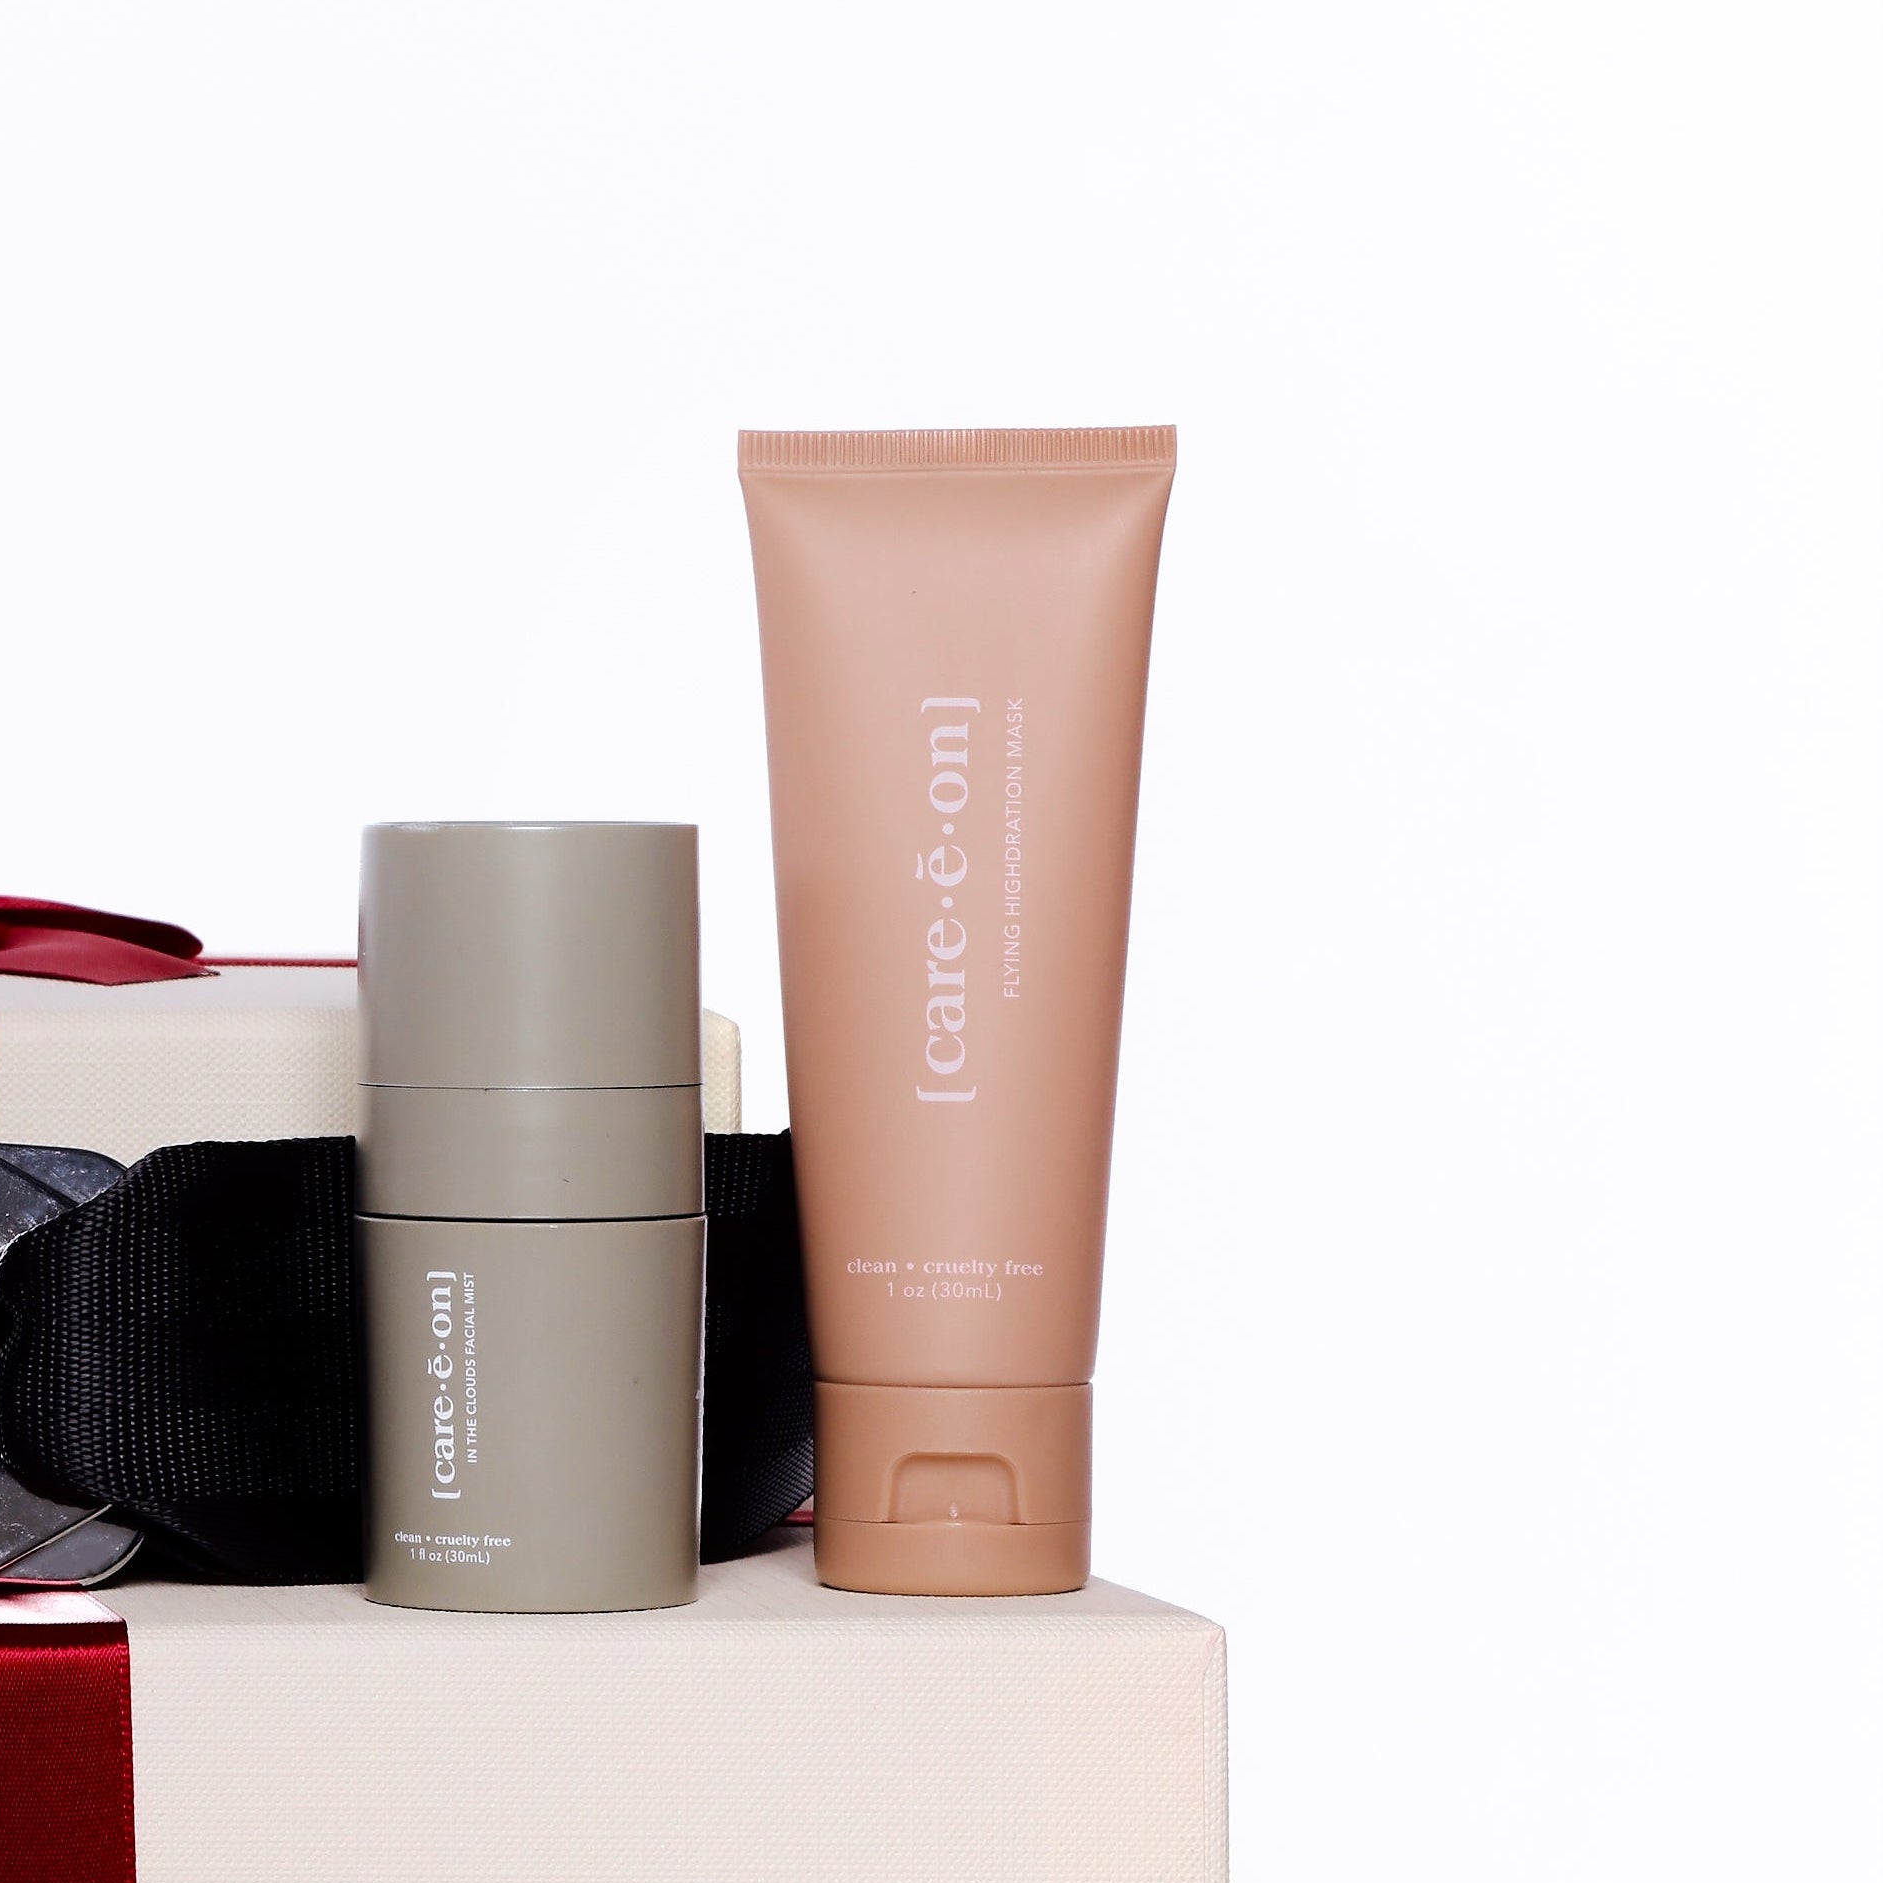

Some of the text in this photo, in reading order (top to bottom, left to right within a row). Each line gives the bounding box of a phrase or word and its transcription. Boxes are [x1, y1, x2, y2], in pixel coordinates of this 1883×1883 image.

[1003, 697, 1024, 998] FLYING HIGHDRATION MASK
[846, 1258, 897, 1274] clean
[923, 1259, 997, 1278] cruelty
[1004, 1260, 1044, 1276] free
[886, 1281, 1002, 1302] 1 oz (30mL)
[462, 1272, 478, 1463] IN THE CLOUDS FACIAL MIST
[394, 1531, 422, 1544] clean
[435, 1534, 480, 1548] cruelty
[483, 1535, 512, 1547] free
[410, 1548, 490, 1565] 1 fl oz (30mL)
